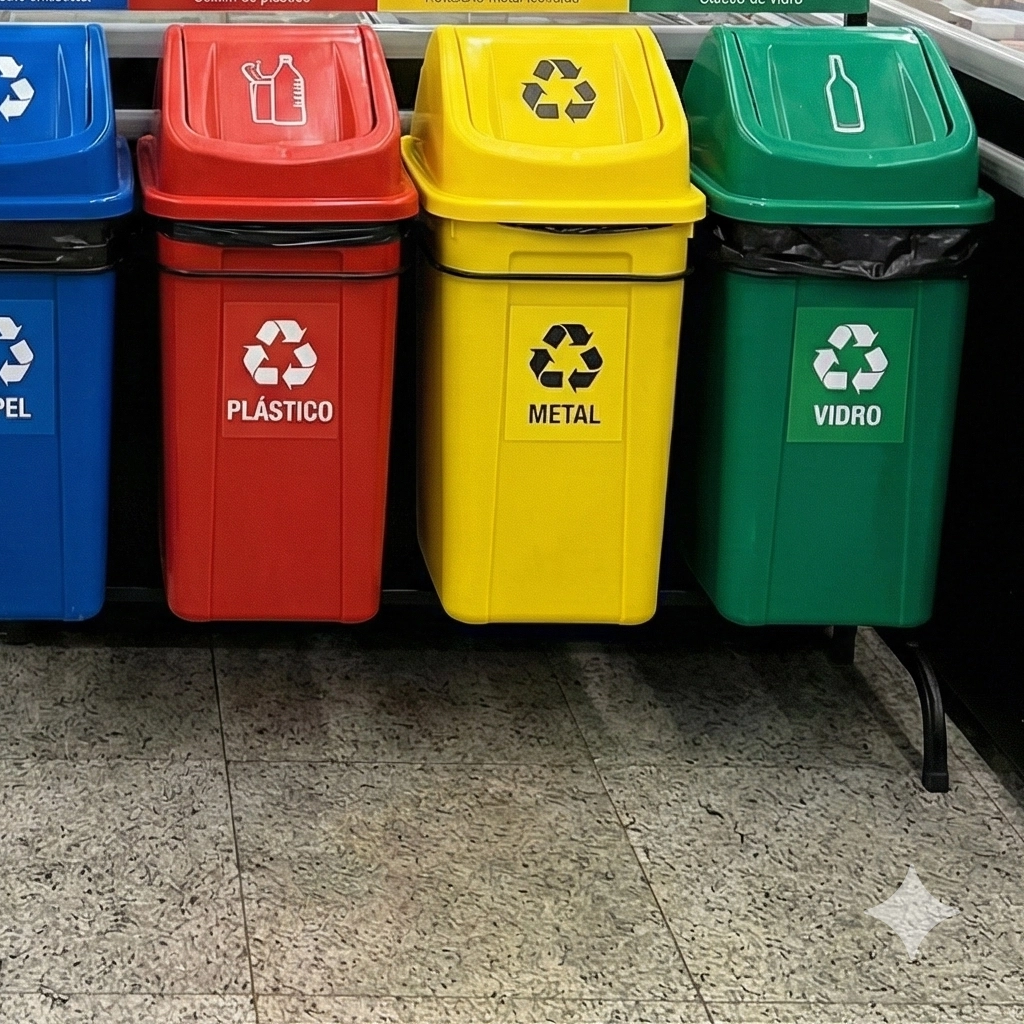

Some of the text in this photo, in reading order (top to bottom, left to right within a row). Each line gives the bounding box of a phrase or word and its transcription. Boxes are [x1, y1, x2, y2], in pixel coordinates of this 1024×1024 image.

[227, 395, 333, 422] PLÁSTICO
[529, 404, 601, 425] METAL
[813, 404, 882, 426] VIDRO
